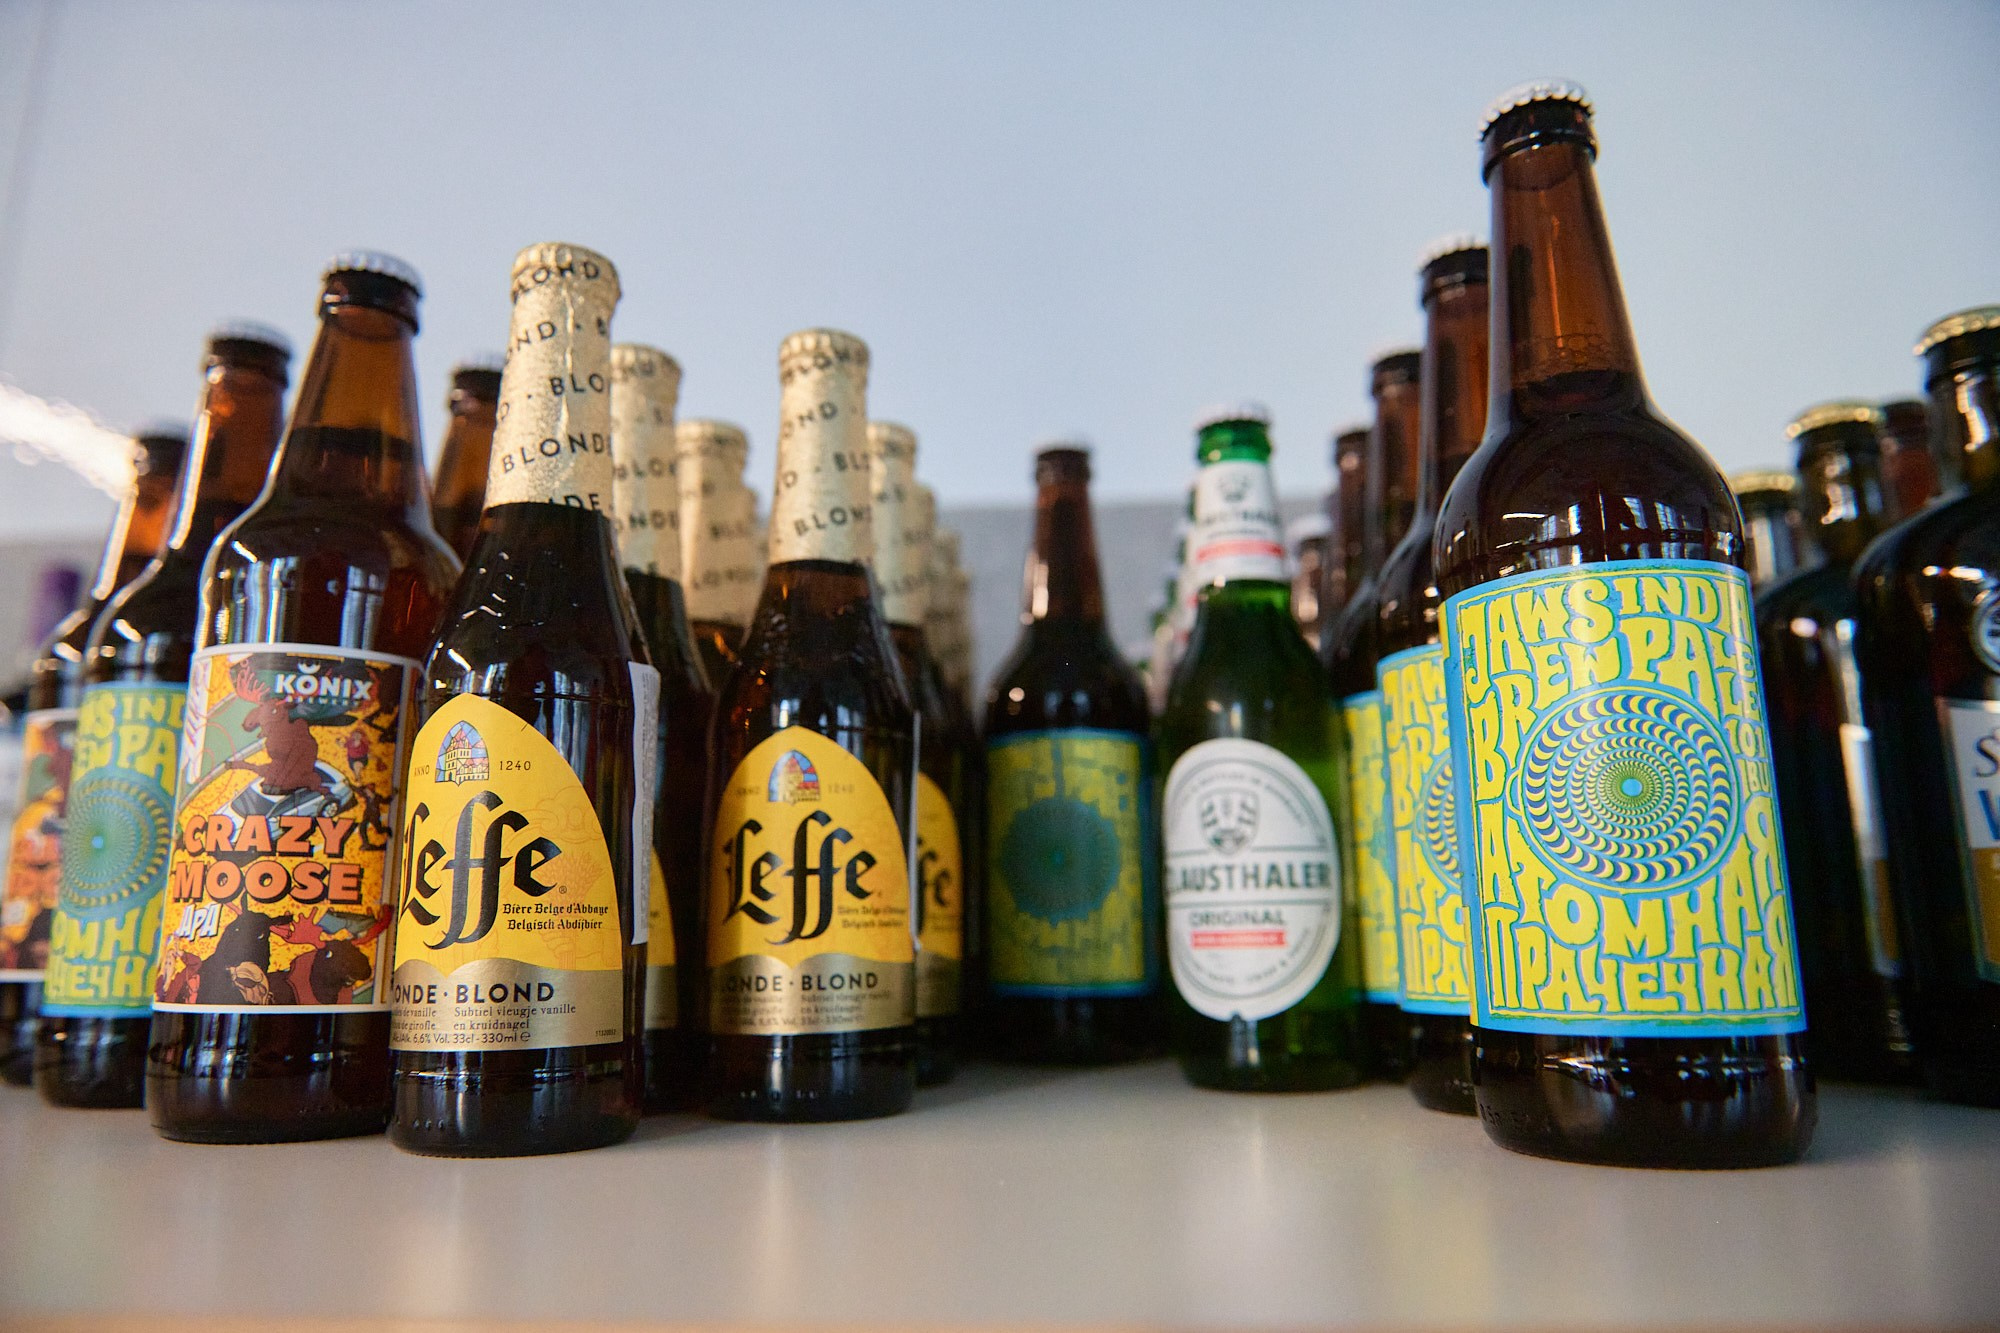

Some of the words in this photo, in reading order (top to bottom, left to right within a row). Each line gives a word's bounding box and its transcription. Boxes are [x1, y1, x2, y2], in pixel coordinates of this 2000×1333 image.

[1461, 578, 1615, 704] JAWS
[499, 760, 531, 771] 1240
[183, 814, 359, 858] CRAZY
[399, 789, 562, 950] Leffe
[723, 809, 878, 946] Leffe
[173, 859, 364, 905] MOOSE
[503, 903, 532, 914] Bière
[534, 903, 564, 916] Belge
[1188, 909, 1287, 928] ORIGINAL
[176, 902, 224, 942] APA
[507, 919, 555, 932] Belgisch
[801, 972, 879, 991] BLOND
[455, 982, 555, 1005] BLOND
[454, 1006, 493, 1018] Subtiel
[496, 1005, 537, 1019] vleugje
[541, 1003, 577, 1015] vanille
[453, 1023, 466, 1031] en
[469, 1019, 530, 1032] kruidnagel
[453, 1032, 475, 1044] 33cl
[482, 1031, 517, 1043] 330ml
